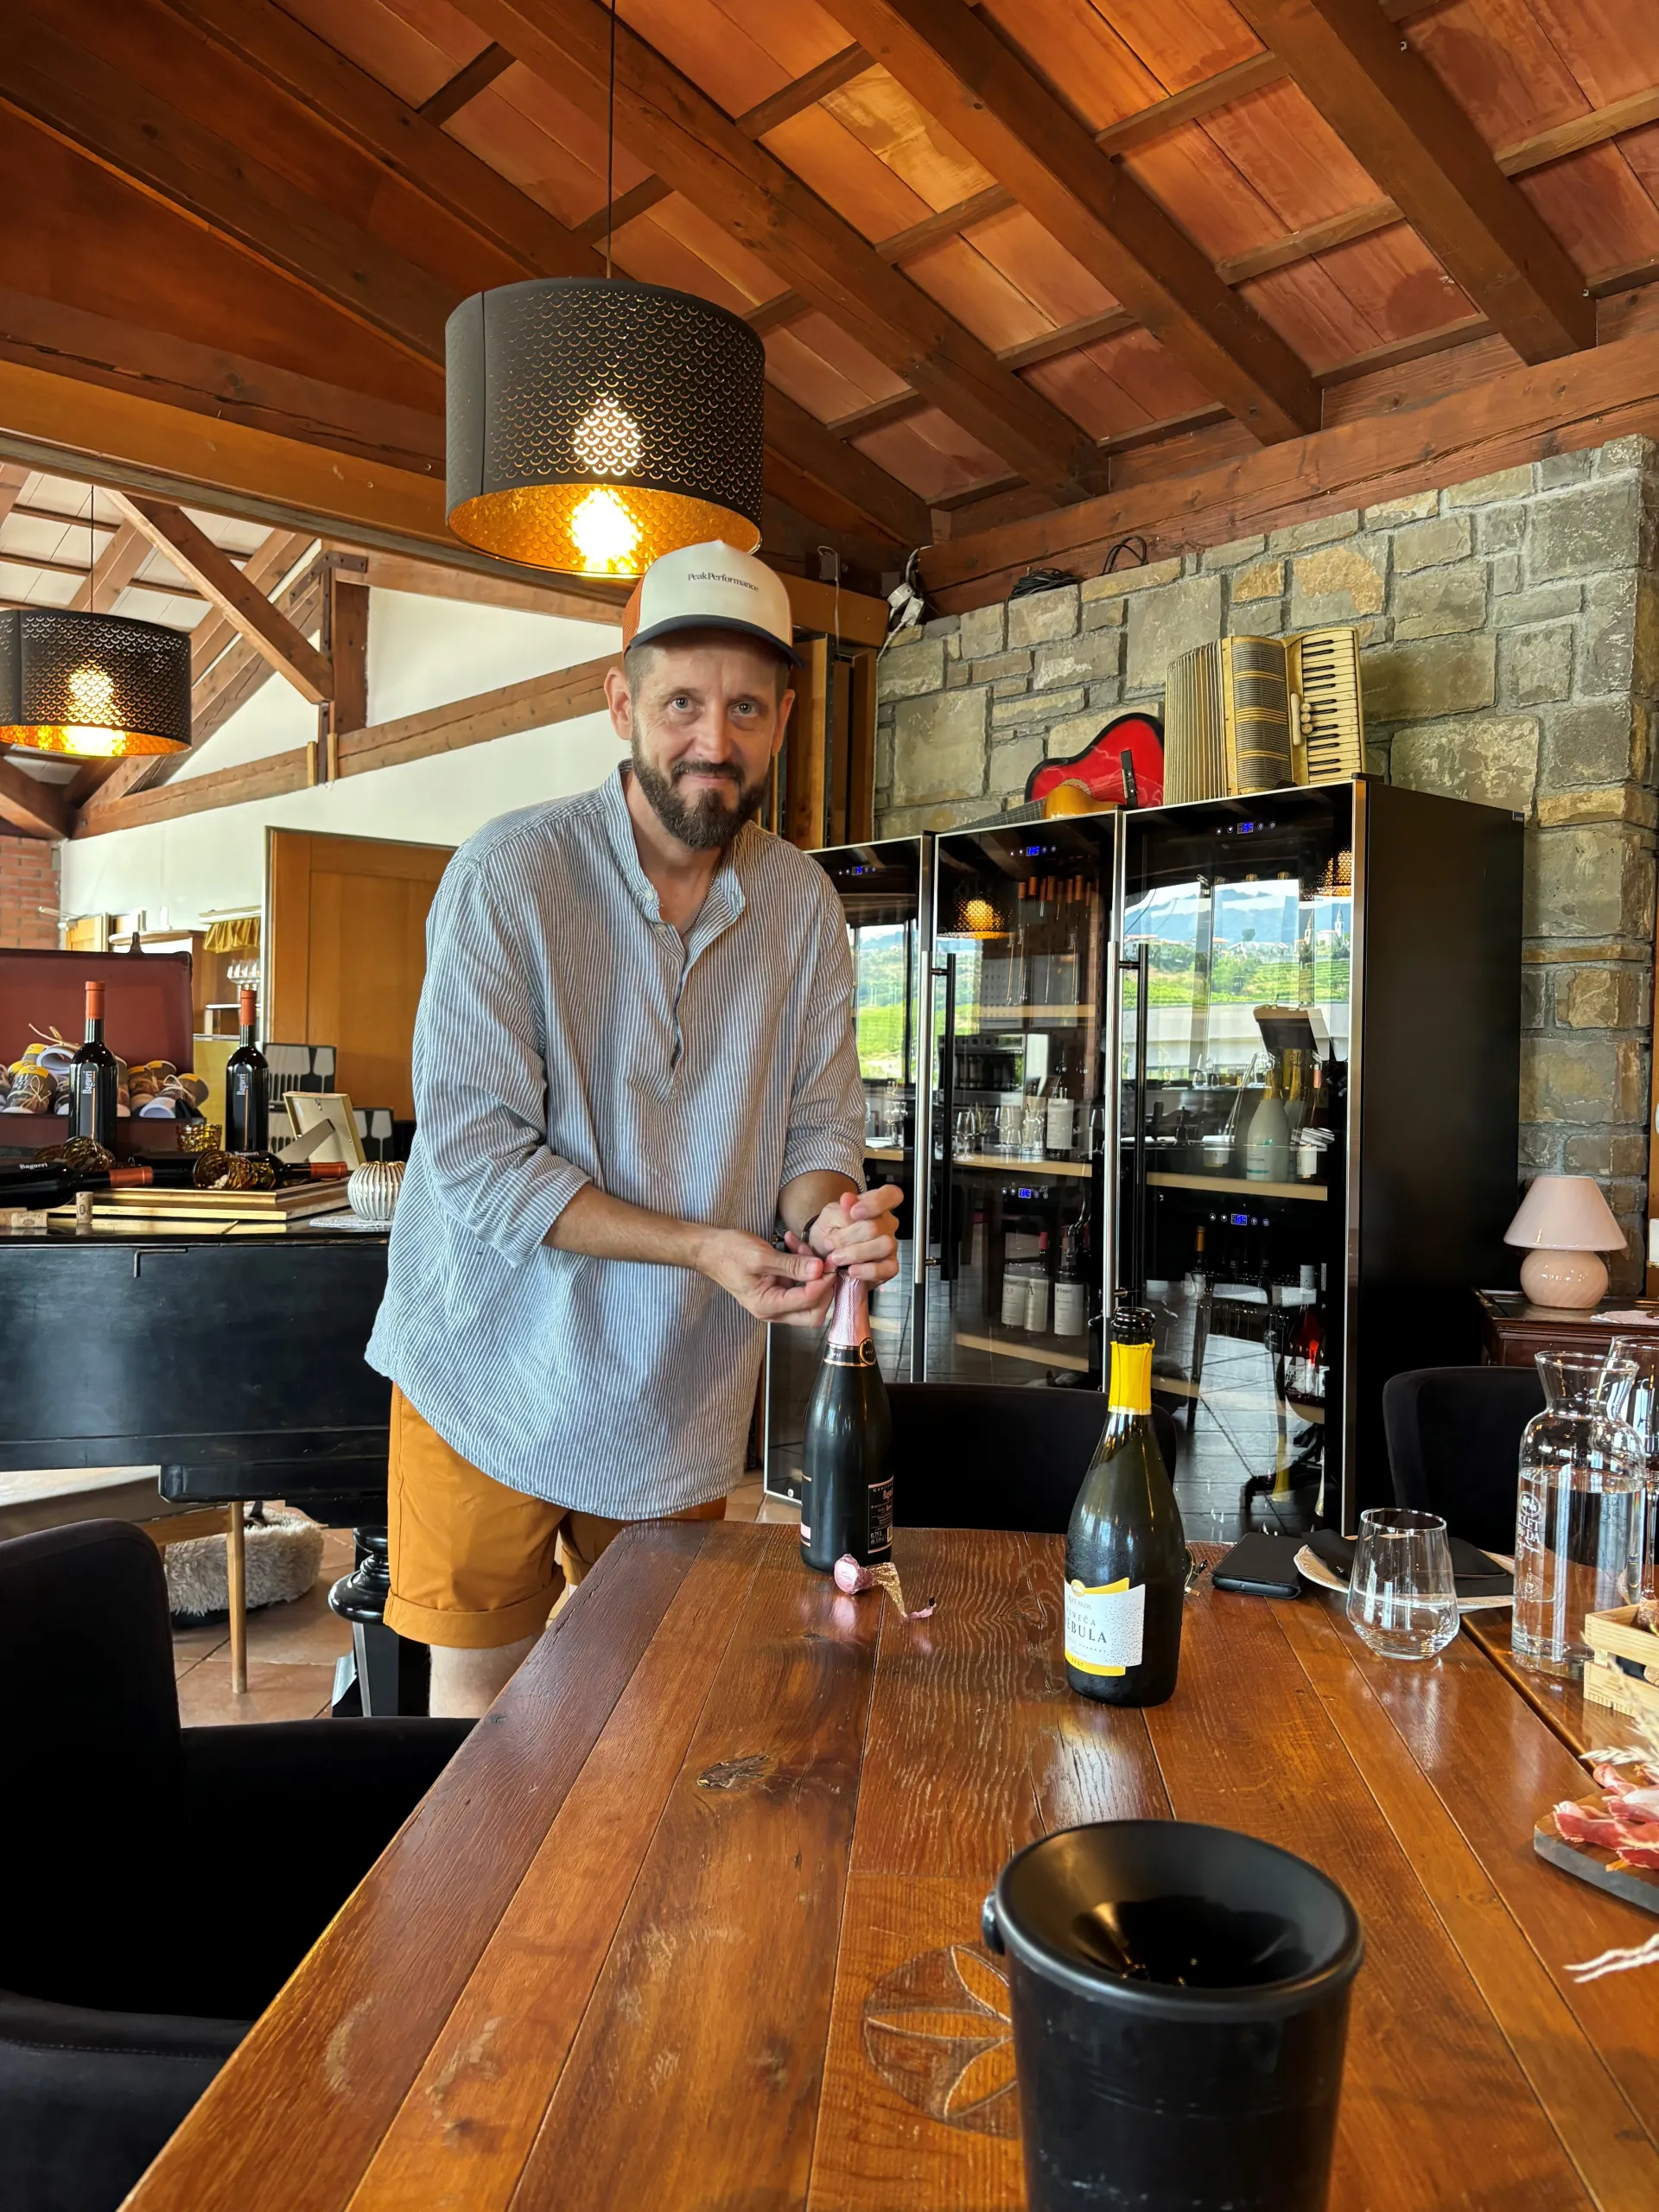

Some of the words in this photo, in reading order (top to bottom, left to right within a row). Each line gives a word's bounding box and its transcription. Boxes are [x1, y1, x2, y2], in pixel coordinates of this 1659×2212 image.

[81, 1071, 95, 1094] Bagueri
[236, 1073, 249, 1096] Bagueri
[19, 1162, 48, 1171] Bagueri
[1517, 1514, 1541, 1532] KLET
[1065, 1617, 1108, 1644] EBULA
